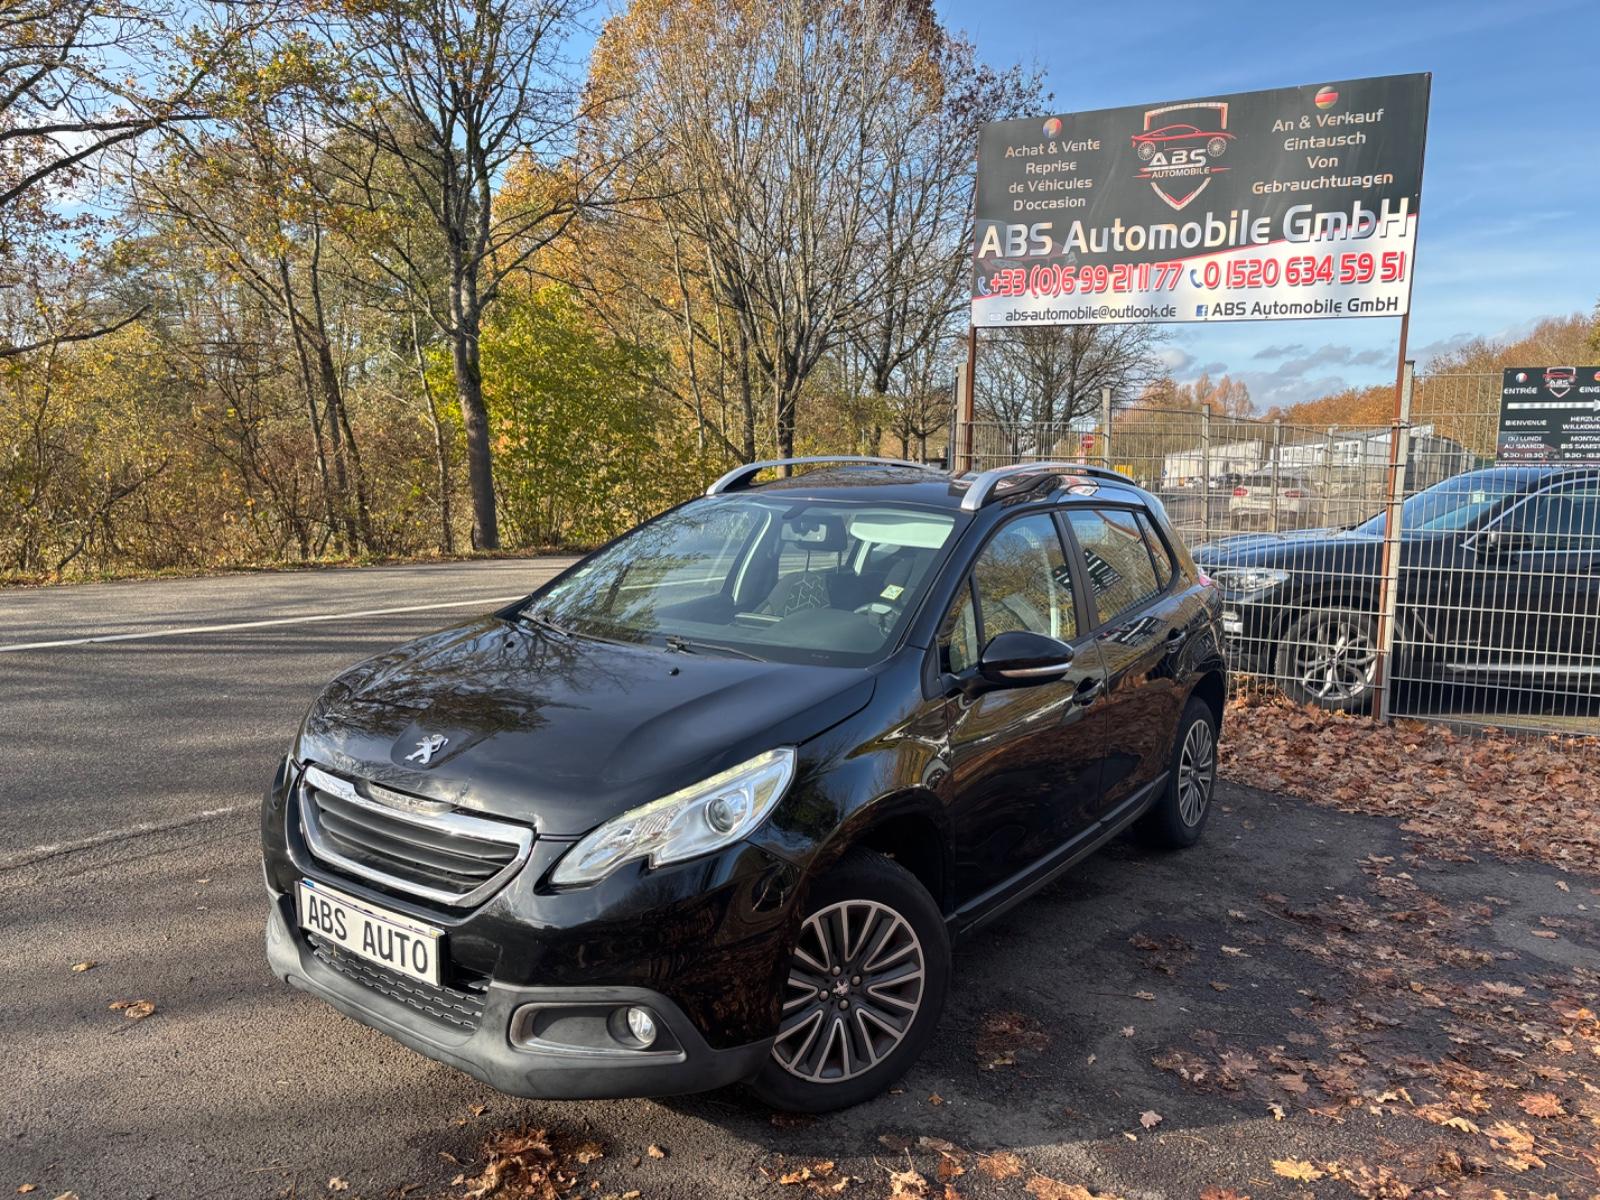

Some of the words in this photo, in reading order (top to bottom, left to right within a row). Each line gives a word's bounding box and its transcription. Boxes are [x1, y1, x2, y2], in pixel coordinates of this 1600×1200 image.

[1272, 119, 1294, 132] An
[1299, 115, 1311, 129] &
[1316, 108, 1384, 127] Verkauf
[1005, 140, 1044, 158] Achat
[1048, 141, 1058, 154] &
[1062, 139, 1101, 153] Vente
[1284, 131, 1366, 150] Eintausch
[1026, 160, 1077, 175] Reprise
[1150, 149, 1207, 167] ABS
[1307, 156, 1338, 168] Von
[1151, 166, 1210, 179] AUTOMOBILE
[1009, 182, 1024, 194] de
[1028, 178, 1093, 192] Véhicules
[1252, 173, 1393, 194] Gebrauchtwagen
[1013, 197, 1086, 211] D'occasion
[978, 222, 1053, 258] ABS
[1062, 209, 1271, 254] Automobile
[1282, 197, 1409, 243] GmbH
[1285, 255, 1333, 286] 634
[1340, 252, 1375, 284] 59
[1381, 251, 1406, 282] 51
[990, 269, 1026, 296] +33
[1030, 264, 1076, 298] (0)6
[1080, 264, 1109, 294] 99
[1153, 263, 1184, 290] 77
[1005, 304, 1176, 321] abs-automobile@outlook.de
[1212, 301, 1247, 316] ABS
[1250, 298, 1342, 316] Automobile
[1347, 297, 1398, 312] GmbH
[309, 894, 347, 941] ABS
[363, 920, 428, 974] AUTO
